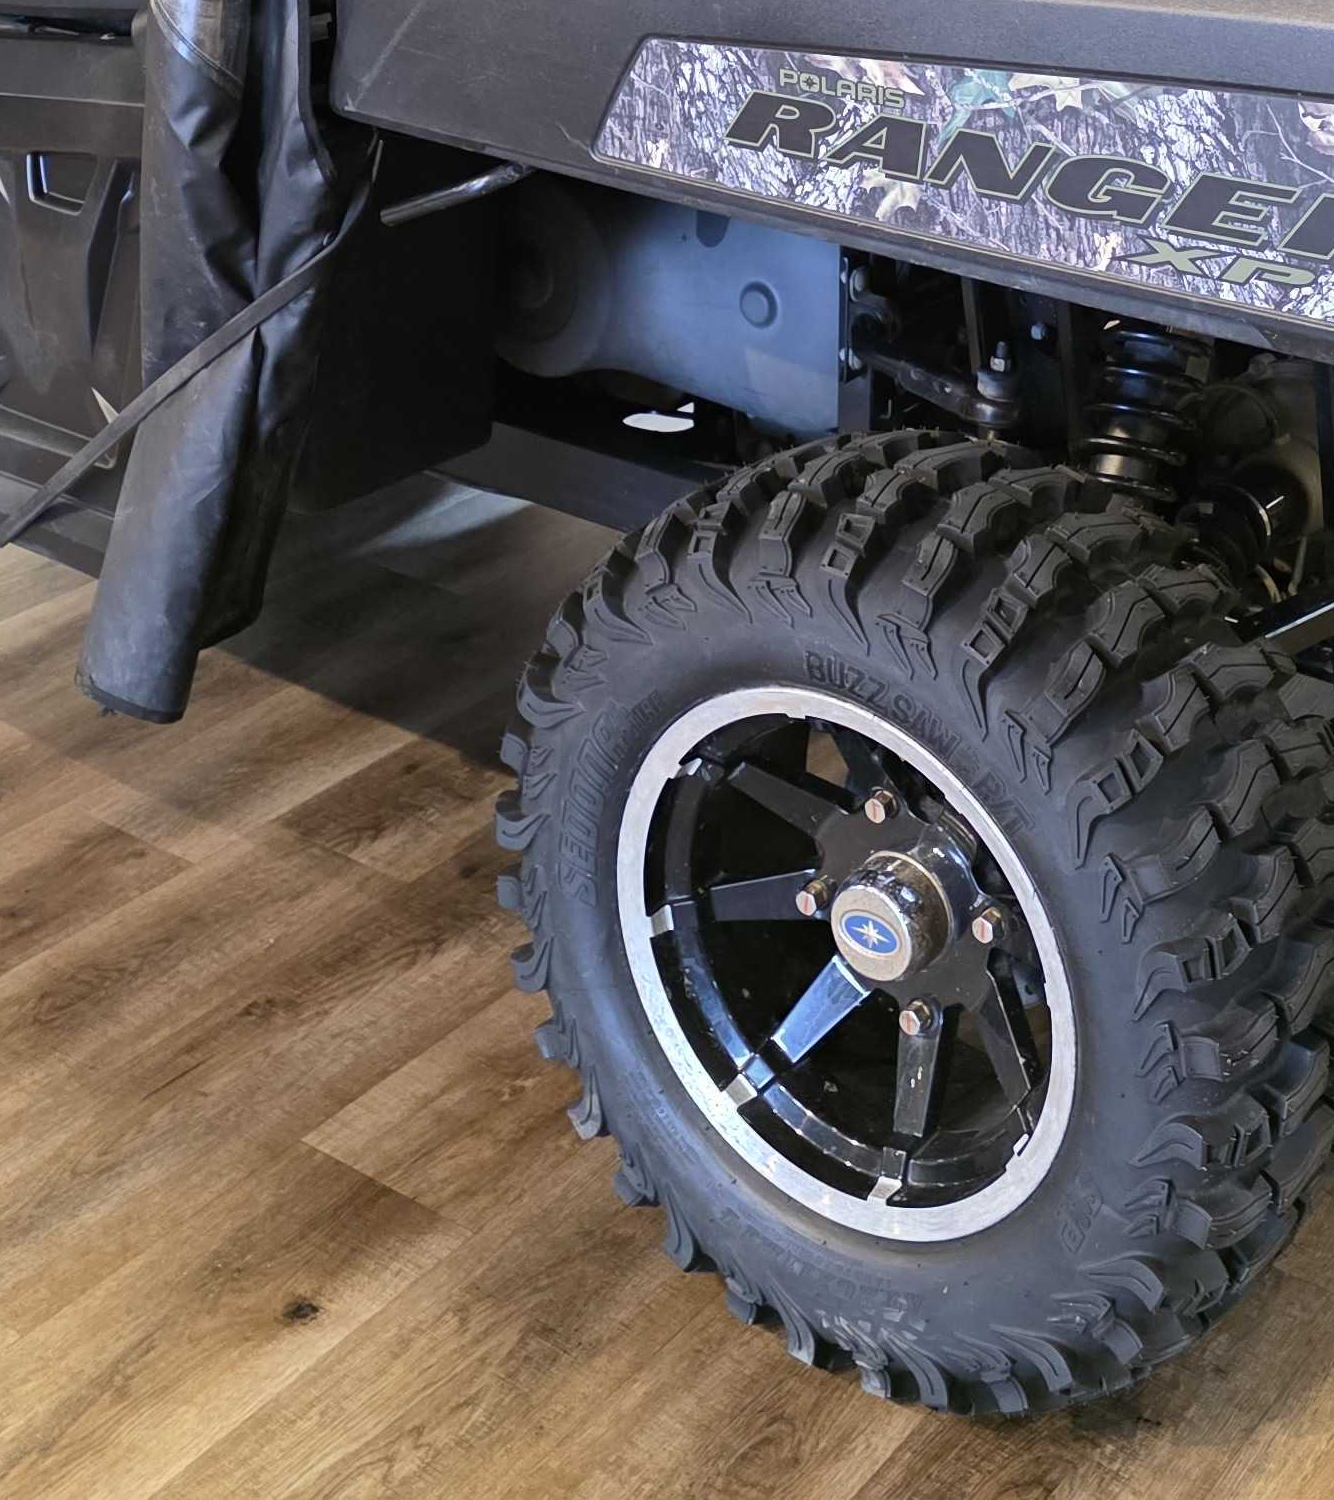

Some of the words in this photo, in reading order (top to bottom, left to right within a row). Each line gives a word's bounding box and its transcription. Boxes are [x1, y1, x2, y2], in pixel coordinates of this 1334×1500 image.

[779, 68, 905, 109] POLARIS
[1110, 235, 1316, 286] XP
[803, 650, 890, 713] BUZZ
